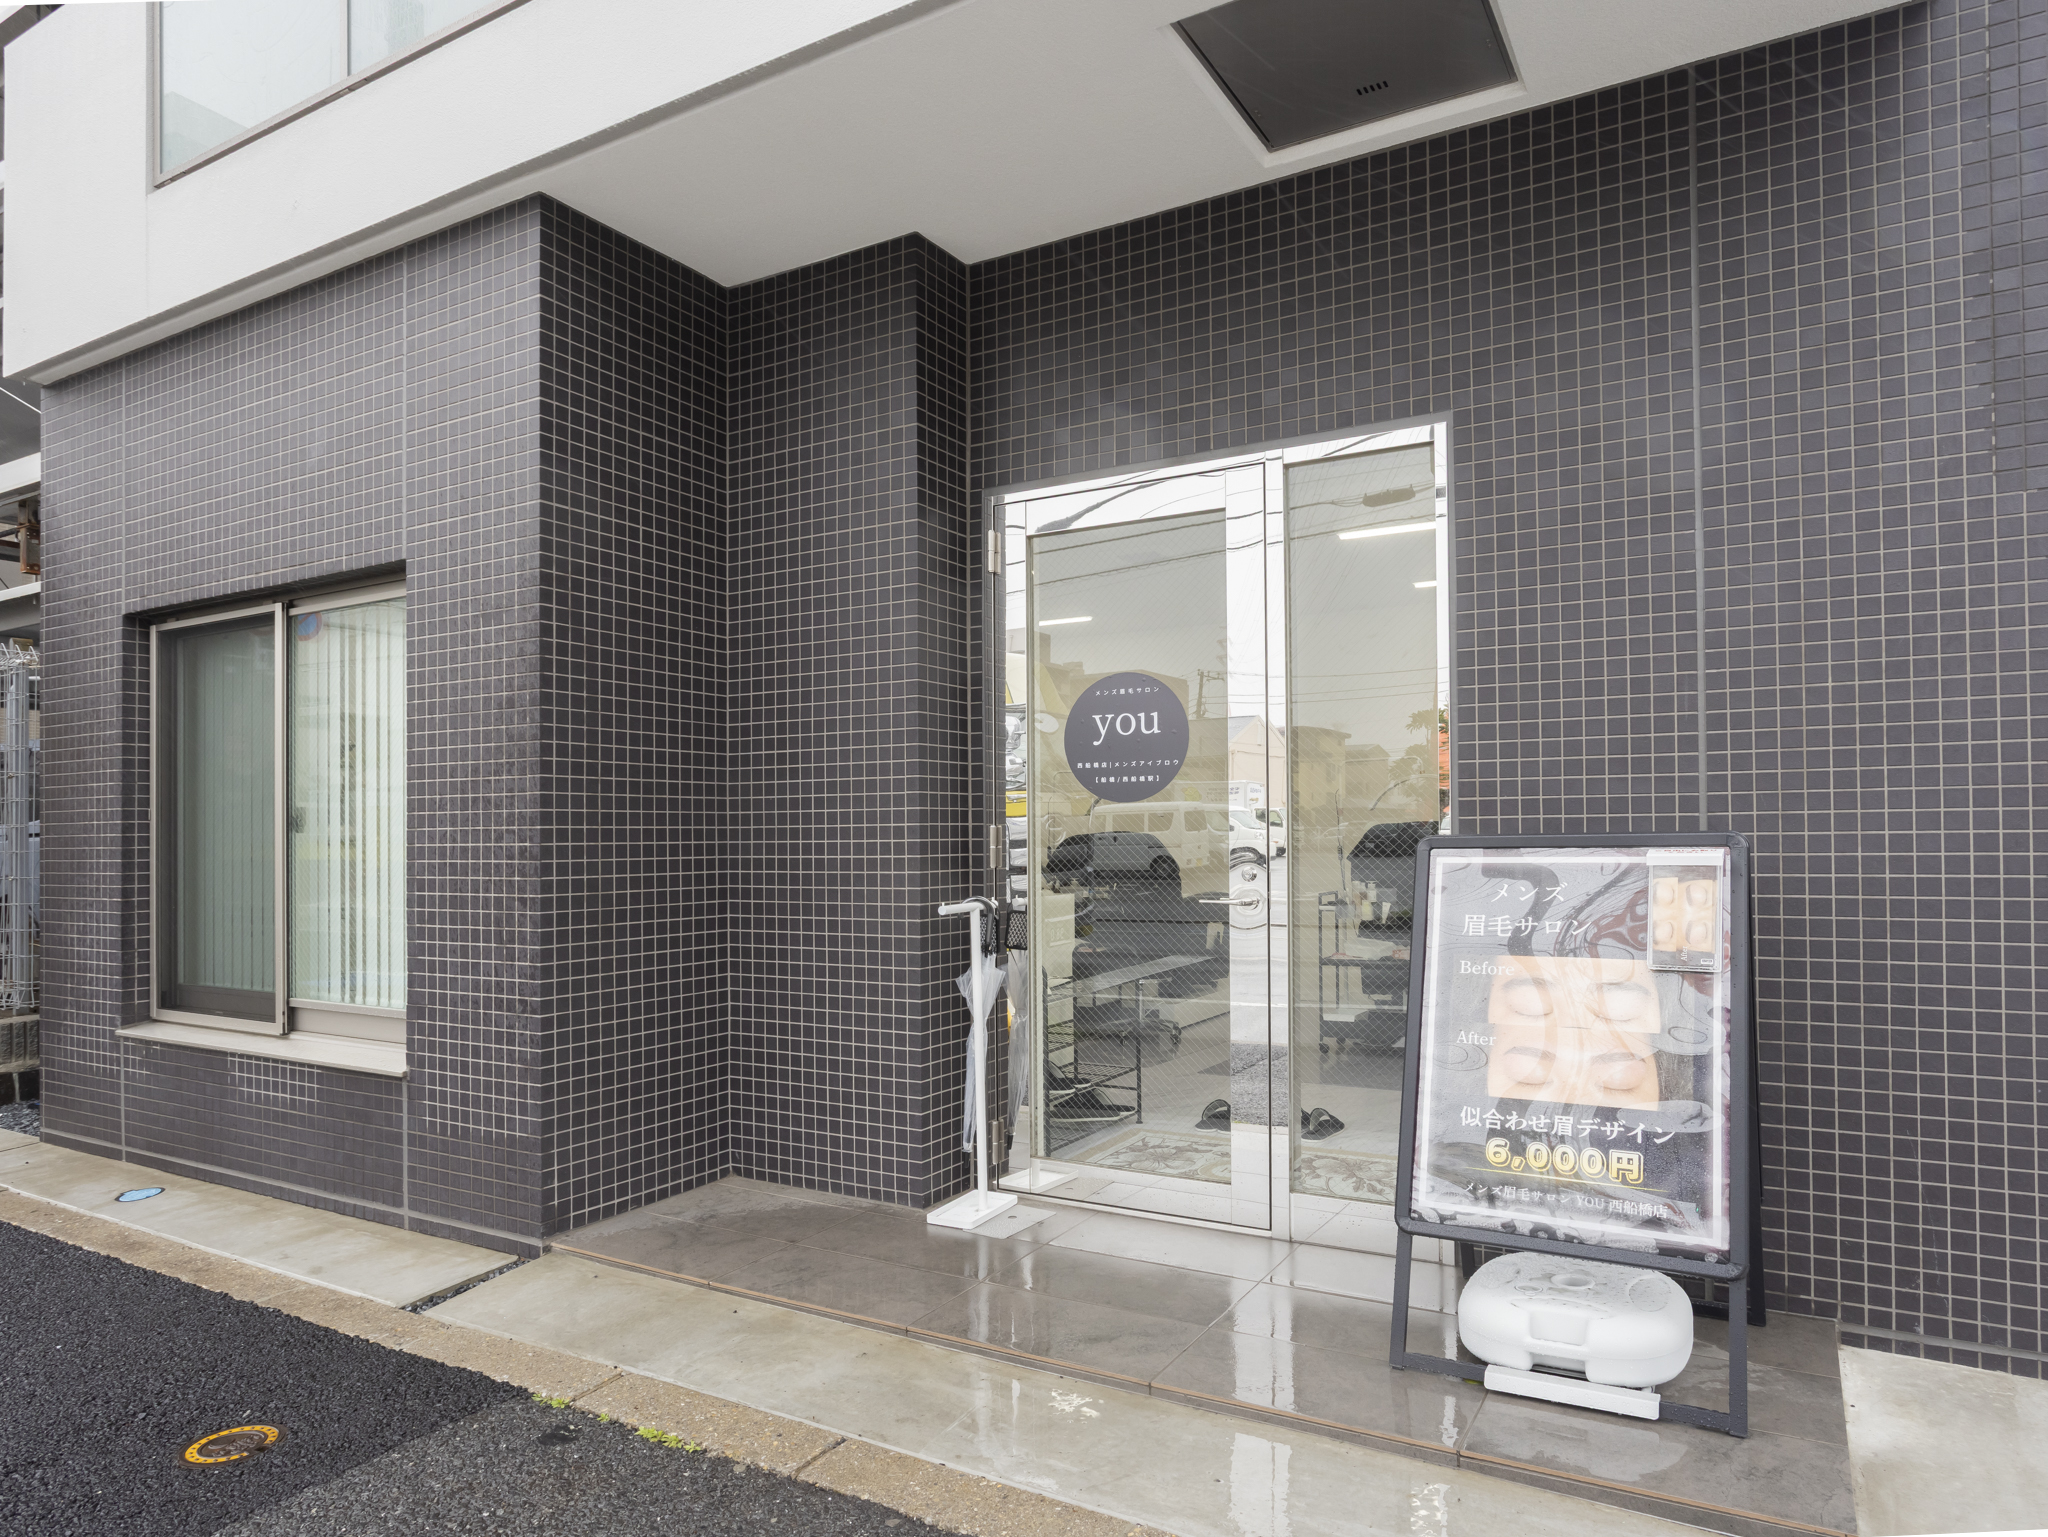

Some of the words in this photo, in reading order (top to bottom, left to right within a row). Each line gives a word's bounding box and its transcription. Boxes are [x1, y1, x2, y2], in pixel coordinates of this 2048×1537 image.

[1092, 711, 1161, 746] you
[1490, 881, 1568, 903] メンズ
[1461, 914, 1592, 937] 眉毛サロン
[1459, 960, 1515, 976] Before
[1456, 1030, 1497, 1046] After
[1460, 1105, 1677, 1145] 似合わせ眉デザイン
[1485, 1137, 1644, 1184] 6,000円
[1464, 1183, 1570, 1204] メンズ眉毛サロン
[1577, 1197, 1605, 1208] YOU
[1608, 1200, 1669, 1219] 西船橋店
